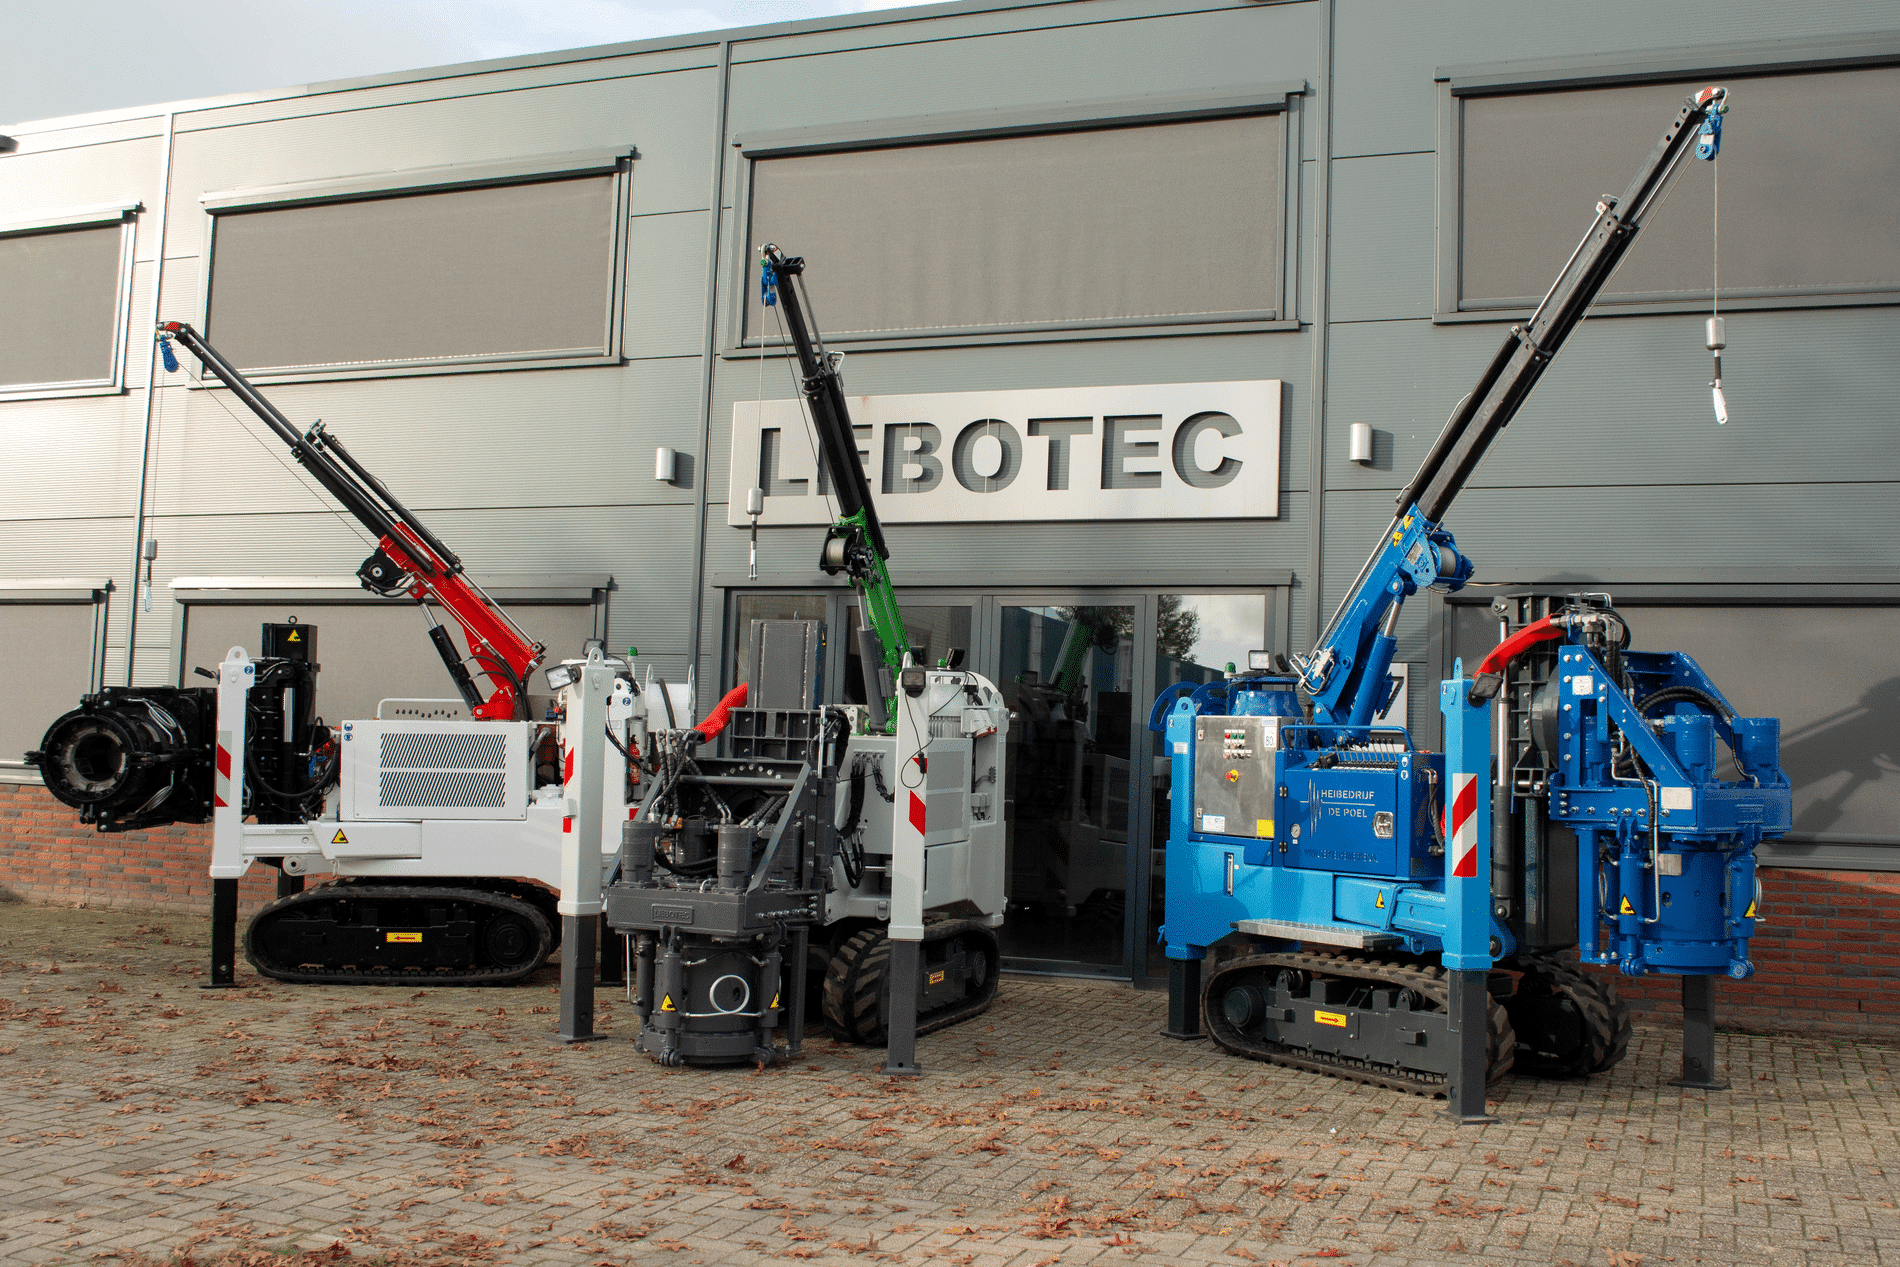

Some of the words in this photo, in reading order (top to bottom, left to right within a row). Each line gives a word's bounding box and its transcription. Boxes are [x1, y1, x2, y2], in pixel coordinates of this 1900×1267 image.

[1321, 789, 1375, 800] HEIBEDRIJF
[1328, 807, 1341, 817] DE
[1344, 808, 1368, 818] POEL
